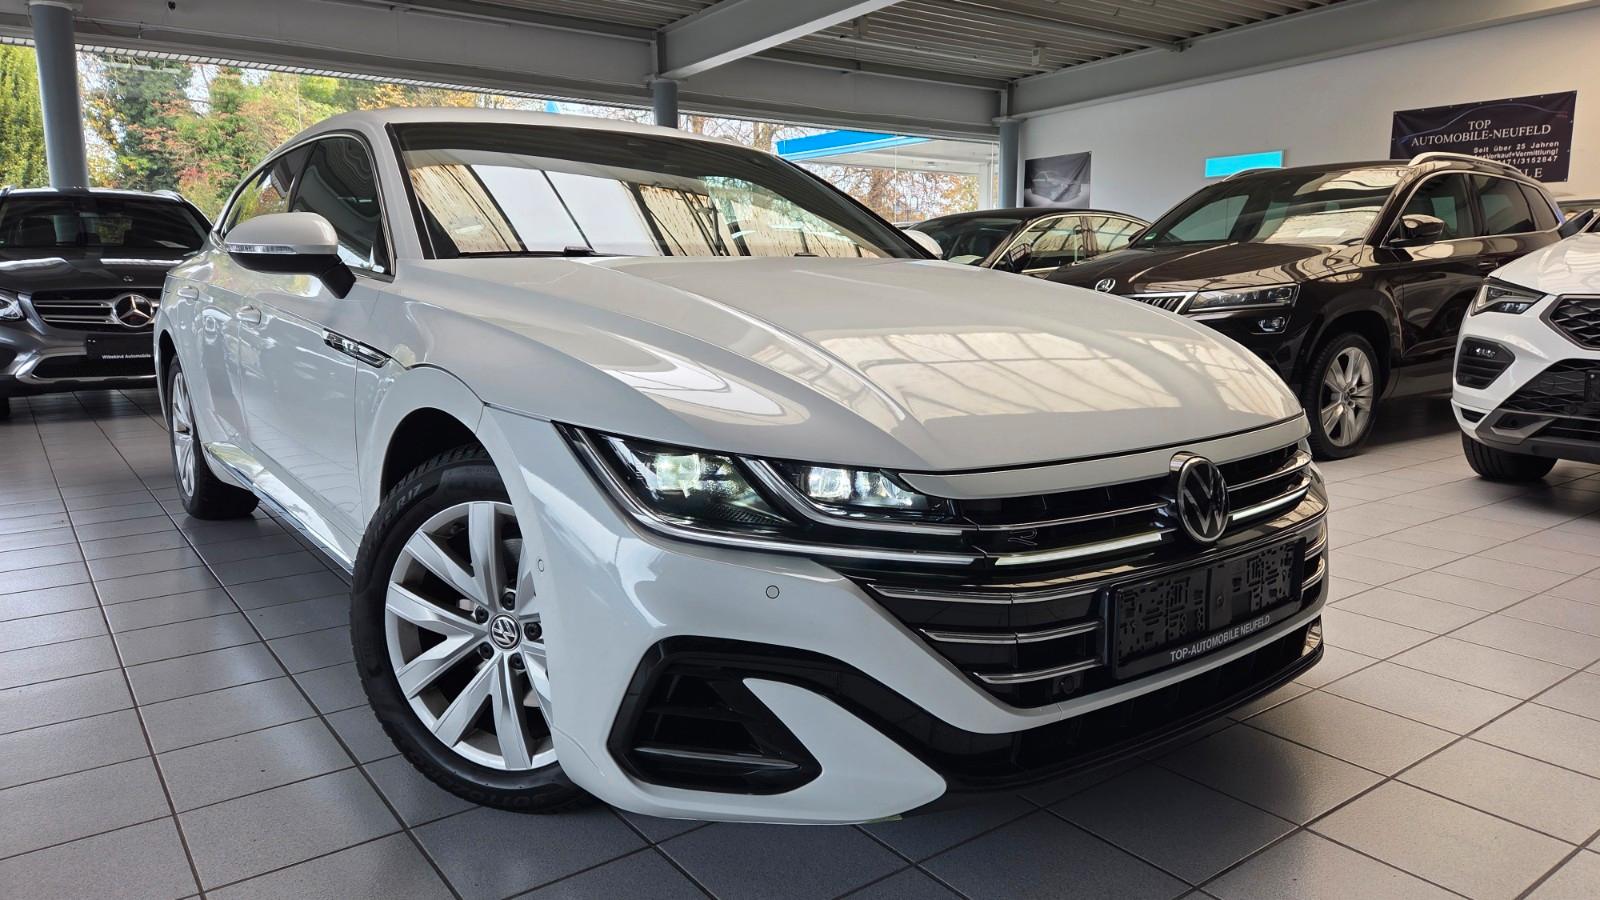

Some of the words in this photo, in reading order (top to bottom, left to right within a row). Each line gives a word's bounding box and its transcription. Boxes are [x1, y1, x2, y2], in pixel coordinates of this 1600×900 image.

[1468, 119, 1492, 131] TOP
[1411, 124, 1551, 147] AUTOMOBILE-NEUFELD
[1473, 146, 1489, 154] Seit
[1530, 140, 1559, 149] Jahren
[1169, 626, 1240, 662] TOP-AUTOMOBILE
[1240, 615, 1271, 635] NEUFELD
